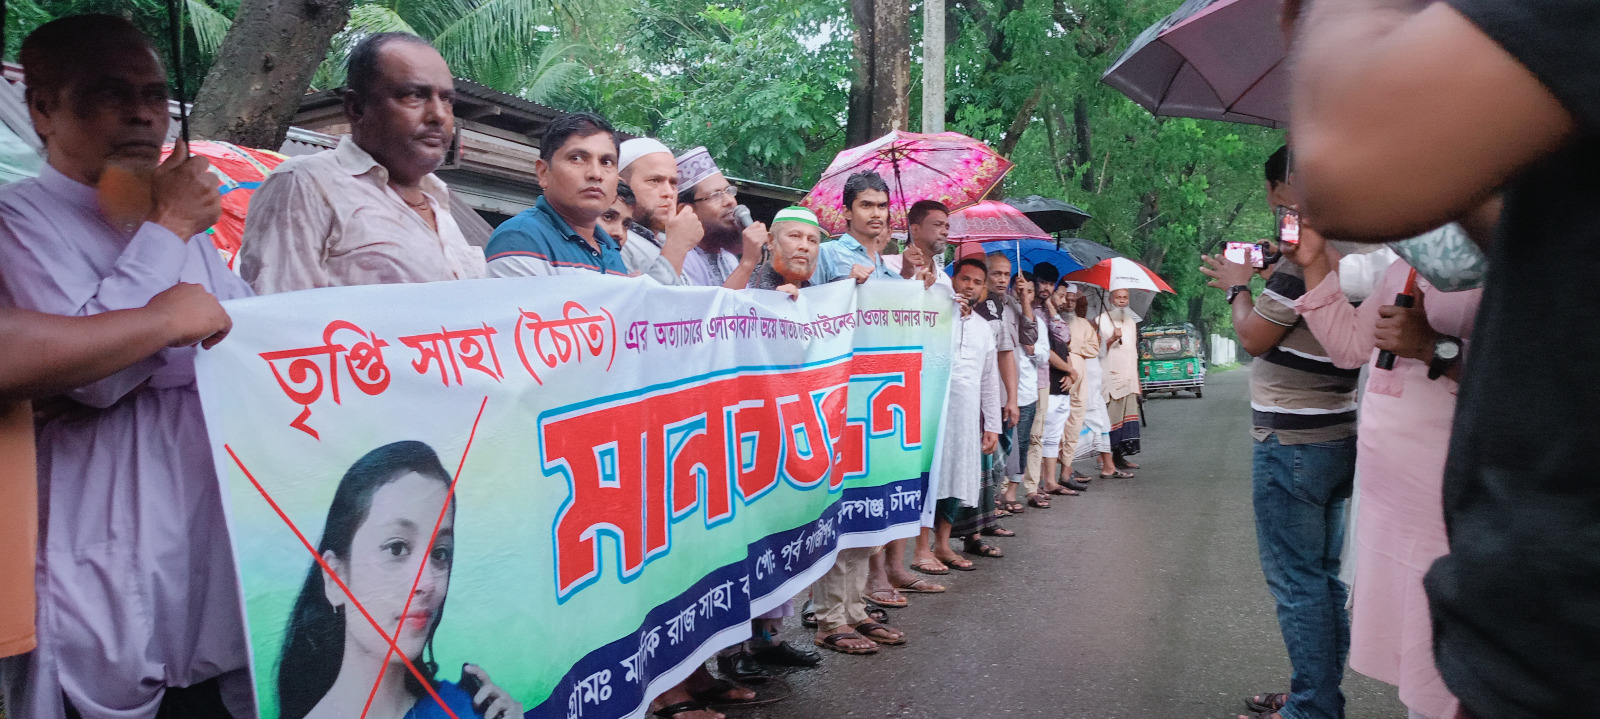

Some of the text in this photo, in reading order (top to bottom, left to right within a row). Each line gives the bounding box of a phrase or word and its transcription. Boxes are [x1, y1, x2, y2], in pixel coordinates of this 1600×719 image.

[258, 300, 617, 441] তৃপ্তি সাহা (চৈতি)
[624, 320, 649, 354] এর
[653, 317, 704, 350] অত্যাচারে
[890, 307, 922, 327] আনার
[665, 602, 697, 646] রাজ
[698, 579, 735, 620] সাহা
[780, 529, 804, 572] পূর্ব
